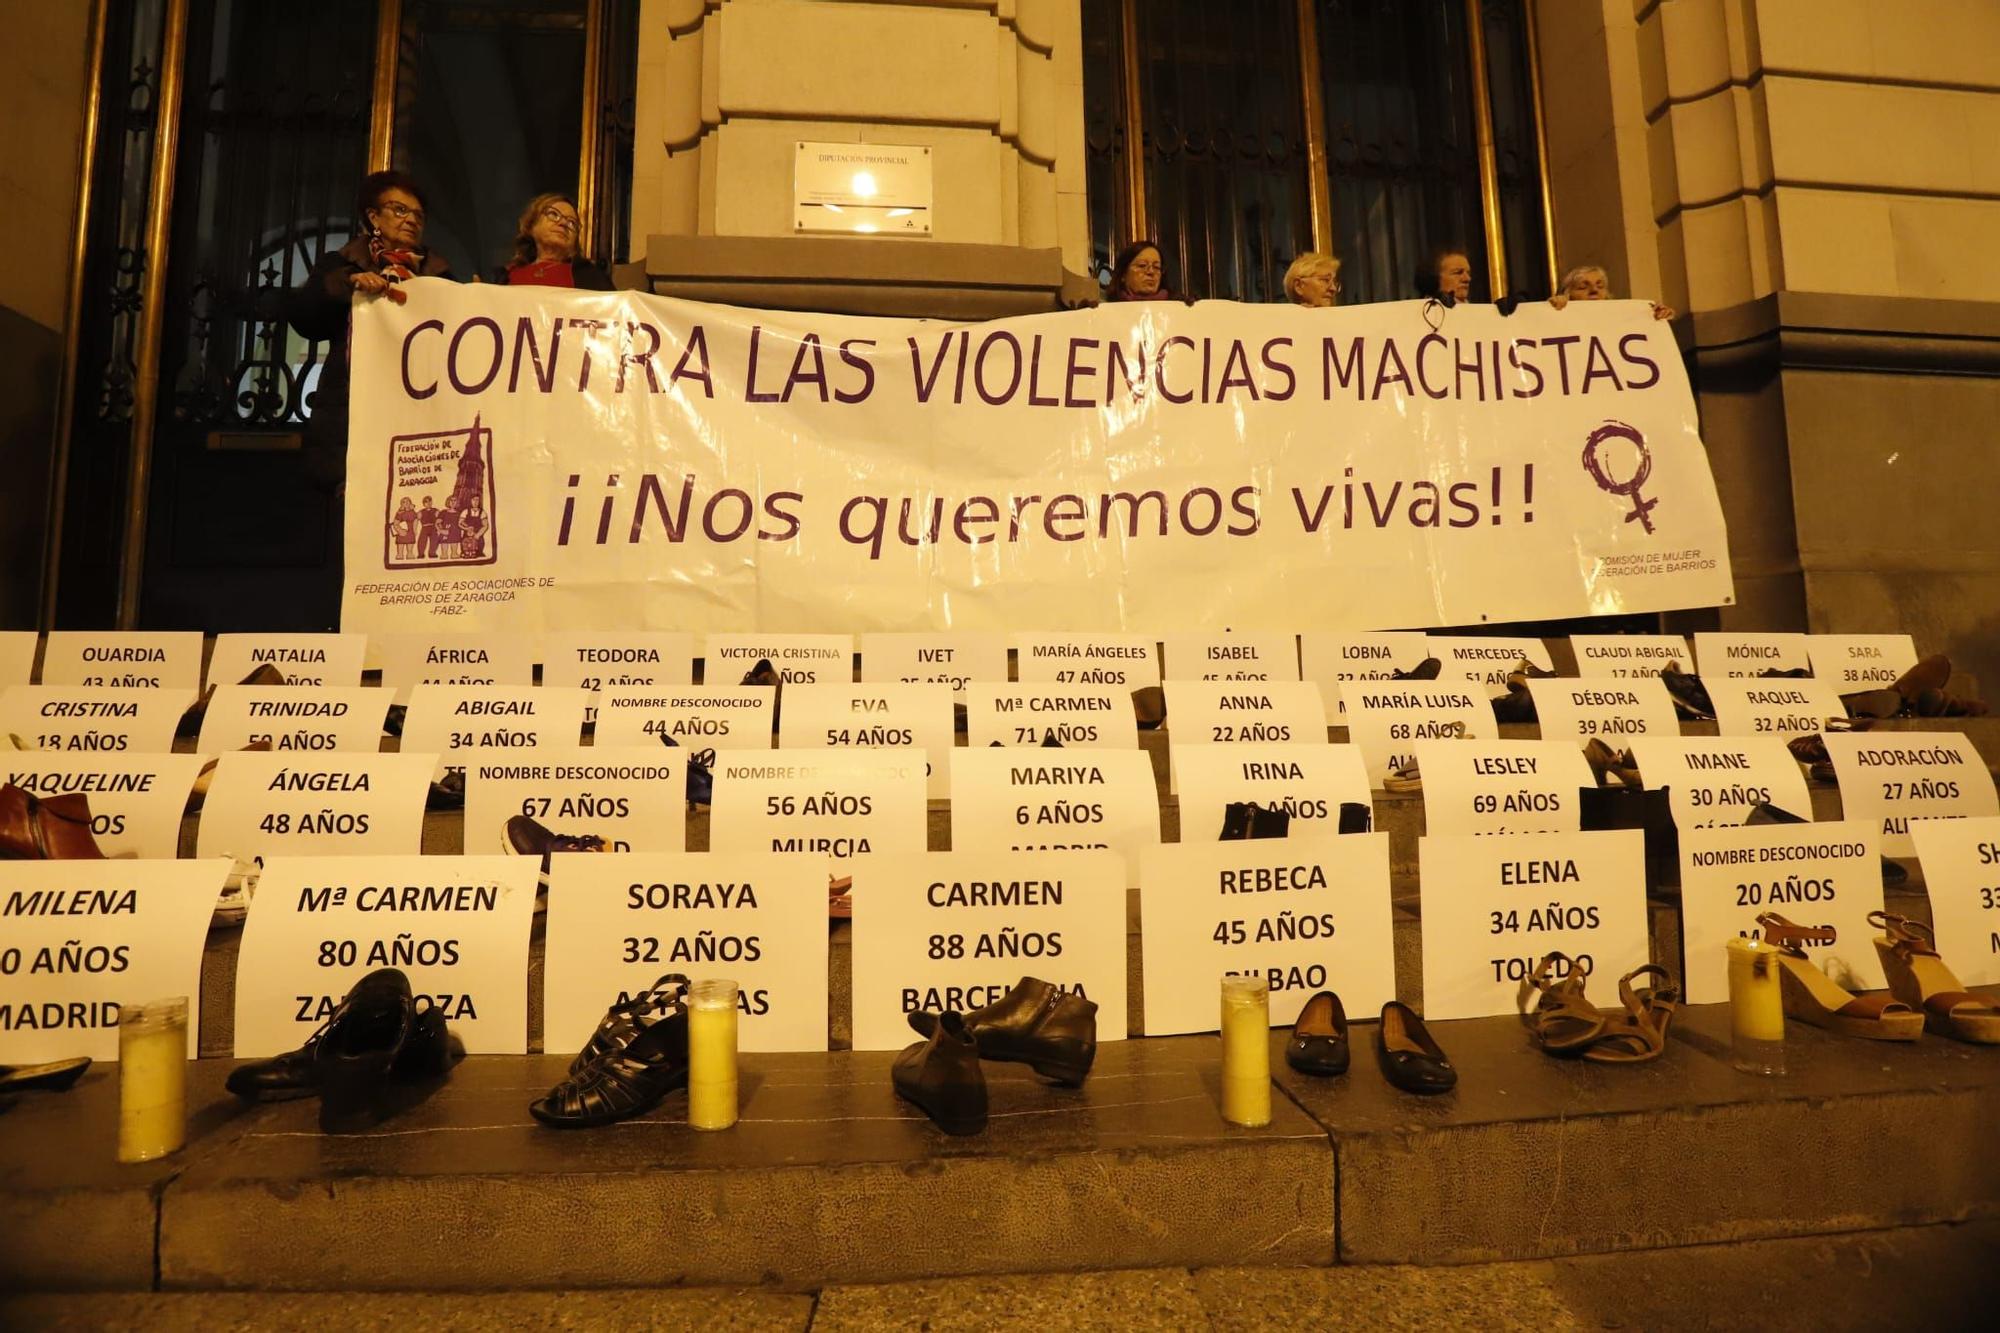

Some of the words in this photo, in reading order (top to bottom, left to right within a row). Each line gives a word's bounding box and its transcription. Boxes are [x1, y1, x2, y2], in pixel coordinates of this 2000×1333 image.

[400, 315, 715, 400] CONTRA
[744, 324, 877, 403] LAS
[907, 331, 1297, 408] VIOLENCIAS
[1322, 333, 1660, 402] MACHISTAS
[838, 481, 1261, 560] queremos
[1291, 463, 1536, 533] vivas!!
[1646, 553, 1660, 563] DE
[1662, 549, 1701, 562] MUJER
[1650, 565, 1664, 574] DE
[1666, 559, 1716, 573] BARRIOS
[355, 580, 433, 595] FEDERACIÓN
[435, 581, 450, 592] DE
[452, 577, 536, 591] ASOCIACIONES
[538, 577, 555, 587] DE
[380, 594, 432, 606] BARRIOS
[435, 593, 451, 604] DE
[454, 591, 515, 603] ZARAGOZA
[429, 605, 467, 616] -FABZ-
[82, 647, 166, 662] OUARDIA
[251, 648, 326, 663] NATALIA
[426, 646, 489, 664] ÁFRICA
[577, 648, 660, 663] TEODORA
[720, 647, 779, 659] VICTORIA
[783, 648, 840, 660] CRISTINA
[918, 648, 954, 663] IVET
[1033, 643, 1081, 658] MARÍA
[1085, 643, 1146, 659] ÁNGELES
[1208, 646, 1259, 660] ISABEL
[1342, 646, 1392, 660] LOBNA
[1454, 648, 1526, 660] MERCEDES
[1585, 647, 1632, 658] CLAUDI
[1635, 647, 1684, 658] ABIGAIL
[1727, 643, 1781, 659] MÓNICA
[1848, 647, 1882, 658] SARA
[779, 669, 815, 684] ÑOS
[1056, 671, 1075, 684] 47
[1080, 668, 1126, 684] AÑOS
[1843, 669, 1859, 682] 38
[1862, 667, 1896, 682] AÑOS
[581, 678, 601, 691] 42
[611, 698, 667, 708] NOMBRE
[671, 698, 762, 708] DESCONOCIDO
[851, 699, 889, 713] EVA
[1029, 697, 1112, 711] CARMEN
[1219, 696, 1273, 710] ANNA
[1362, 692, 1422, 709] MARÍA
[1425, 695, 1473, 709] LUISA
[1572, 690, 1639, 706] DÉBORA
[1747, 691, 1810, 705] RAQUEL
[40, 702, 138, 717] CRISTINA
[249, 702, 348, 717] TRINIDAD
[455, 701, 535, 716] ABIGAIL
[642, 720, 666, 735] 44
[672, 716, 730, 735] AÑOS
[1390, 724, 1410, 739] 68
[1578, 721, 1597, 735] 39
[1601, 716, 1646, 734] AÑOS
[1754, 718, 1772, 732] 32
[1777, 715, 1818, 732] AÑOS
[37, 735, 61, 750] 18
[67, 731, 128, 751] AÑOS
[278, 730, 336, 751] AÑOS
[450, 733, 473, 749] 34
[480, 729, 537, 747] AÑOS
[827, 729, 850, 745] 54
[856, 725, 912, 745] AÑOS
[1015, 728, 1037, 743] 71
[1213, 727, 1234, 742] 22
[1239, 723, 1290, 742] AÑOS
[1685, 754, 1750, 769] IMANE
[1857, 746, 1964, 767] ADORACIÓN
[479, 766, 550, 780] NOMBRE
[556, 766, 669, 780] DESCONOCIDO
[727, 767, 794, 779] NOMBRE
[1243, 762, 1304, 780] IRINA
[1474, 758, 1537, 775] LESLEY
[268, 768, 370, 791] ÁNGELA
[1011, 767, 1105, 785] MARIYA
[1690, 789, 1713, 806] 30
[1719, 784, 1771, 806] AÑOS
[1883, 783, 1903, 800] 27
[1910, 778, 1960, 800] AÑOS
[522, 798, 552, 818] 67
[559, 793, 629, 818] AÑOS
[767, 796, 795, 816] 56
[802, 792, 872, 816] AÑOS
[1474, 795, 1497, 813] 69
[1504, 790, 1560, 812] AÑOS
[1016, 805, 1030, 825] 6
[1037, 800, 1103, 825] AÑOS
[91, 815, 125, 835] OS
[260, 814, 290, 834] 48
[298, 809, 369, 834] AÑOS
[1692, 848, 1755, 867] NOMBRE
[1759, 843, 1865, 863] DESCONOCIDO
[1220, 865, 1327, 895] REBECA
[1501, 860, 1580, 885] ELENA
[627, 884, 757, 910] SORAYA
[927, 881, 1063, 907] CARMEN
[1736, 883, 1762, 906] 20
[1769, 875, 1835, 904] AÑOS
[3, 890, 137, 917] MILENA
[356, 887, 497, 912] CARMEN
[1490, 910, 1519, 934] 34
[1527, 902, 1600, 932] AÑOS
[1213, 920, 1247, 945] 45
[1255, 911, 1335, 943] AÑOS
[318, 940, 357, 967] 80
[366, 933, 459, 966] AÑOS
[623, 937, 660, 963] 32
[670, 931, 761, 962] AÑOS
[928, 934, 964, 960] 88
[974, 927, 1062, 959] AÑOS
[31, 940, 130, 974] AÑOS
